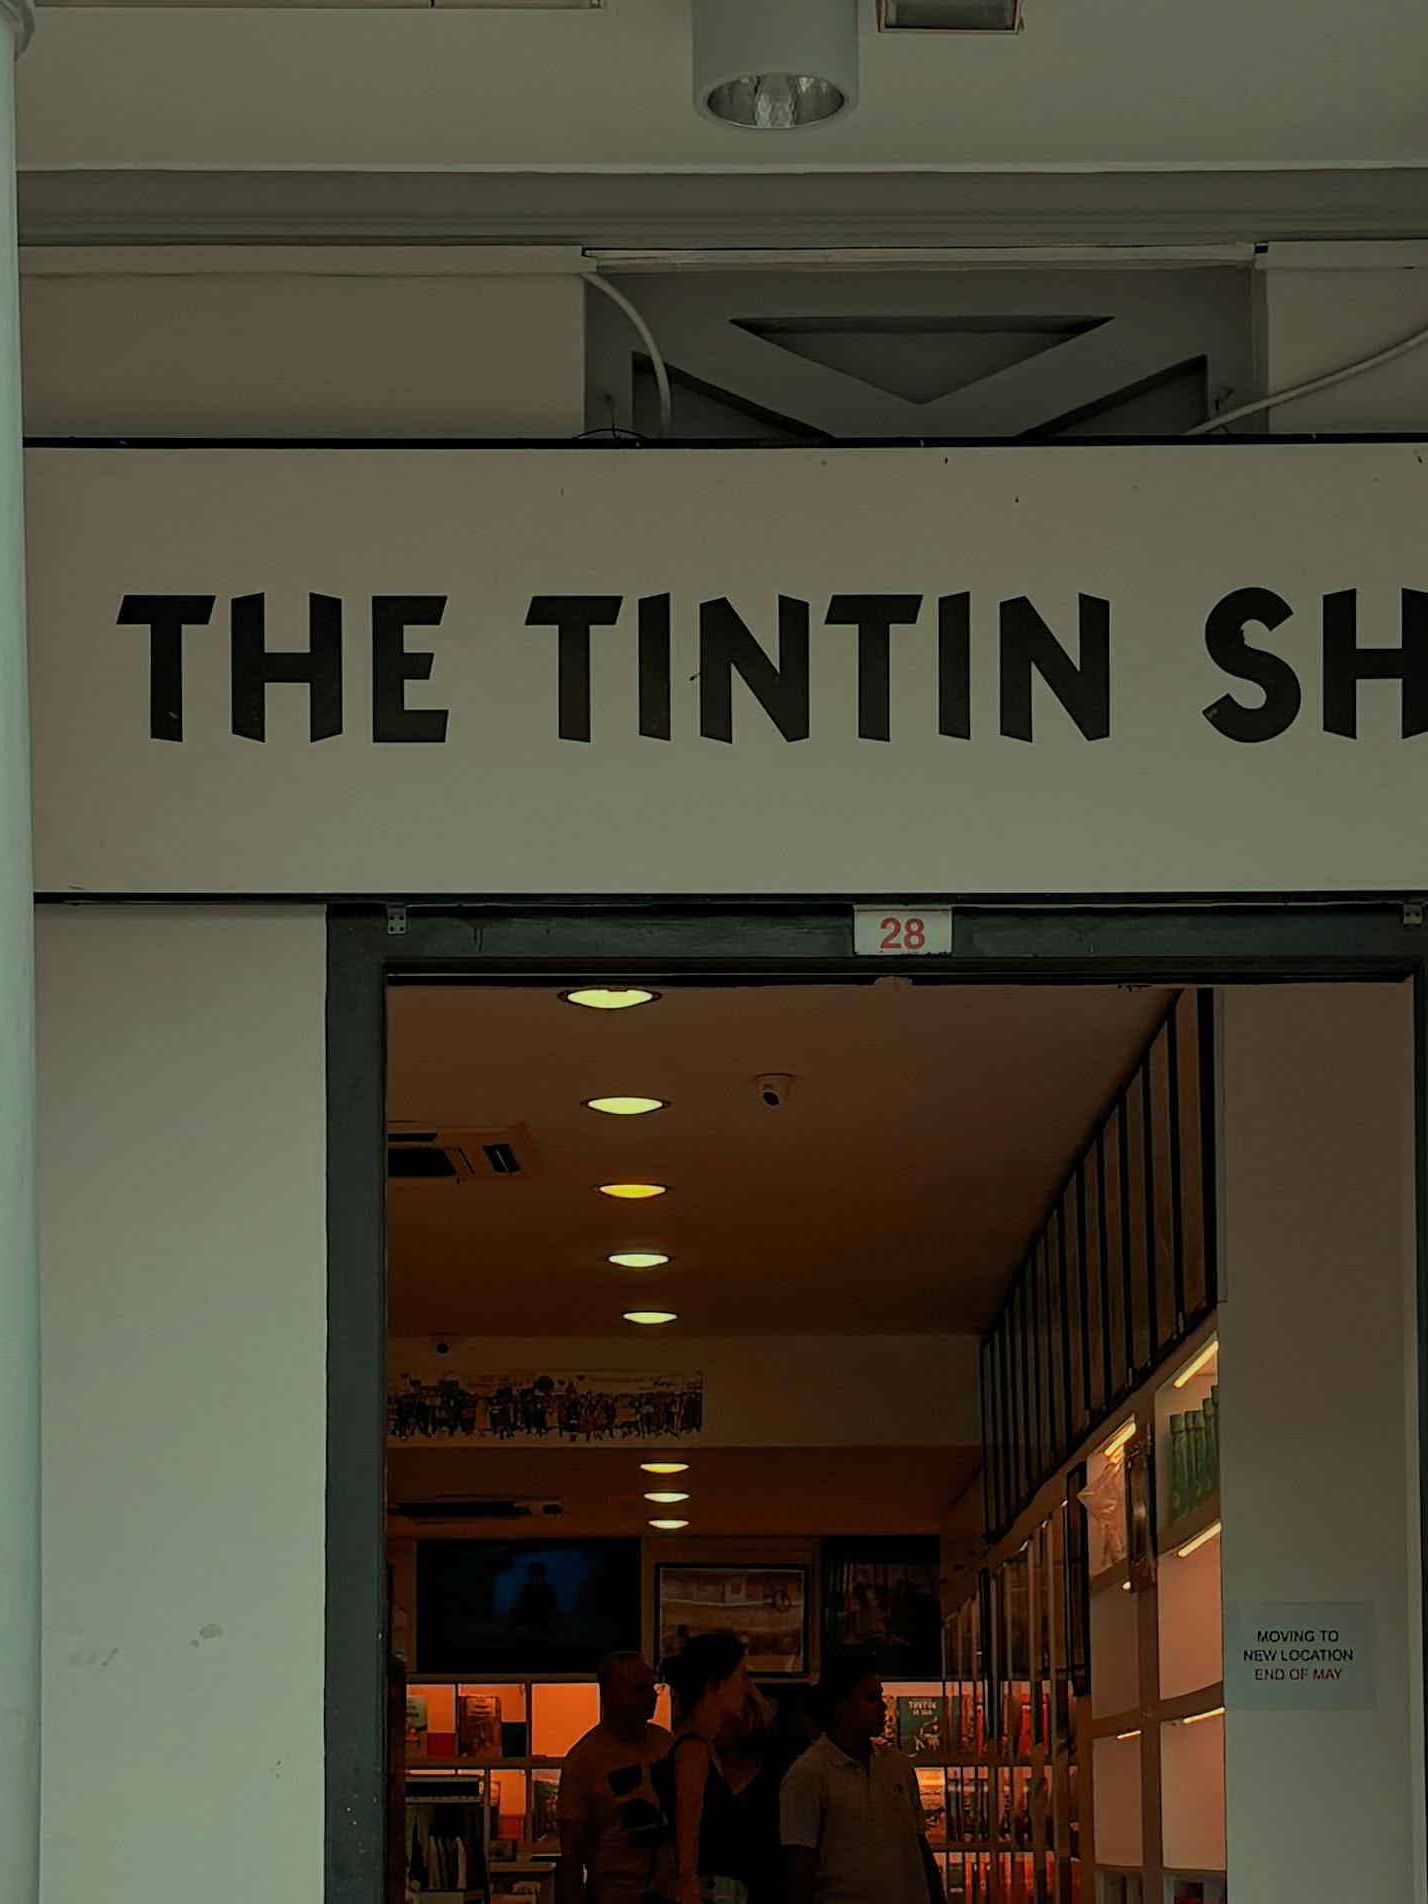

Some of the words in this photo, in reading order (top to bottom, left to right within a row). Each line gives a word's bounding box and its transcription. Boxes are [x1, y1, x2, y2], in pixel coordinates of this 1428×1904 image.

[114, 595, 449, 744] THE
[524, 590, 1112, 744] TINTIN
[879, 917, 926, 950] 28
[1256, 1630, 1315, 1643] MOVING
[1320, 1630, 1339, 1643] TO
[1243, 1649, 1277, 1662] NEW
[1281, 1649, 1354, 1662] LOCATION
[1255, 1668, 1285, 1681] END
[1289, 1668, 1308, 1681] OF
[1313, 1668, 1342, 1681] MAY
